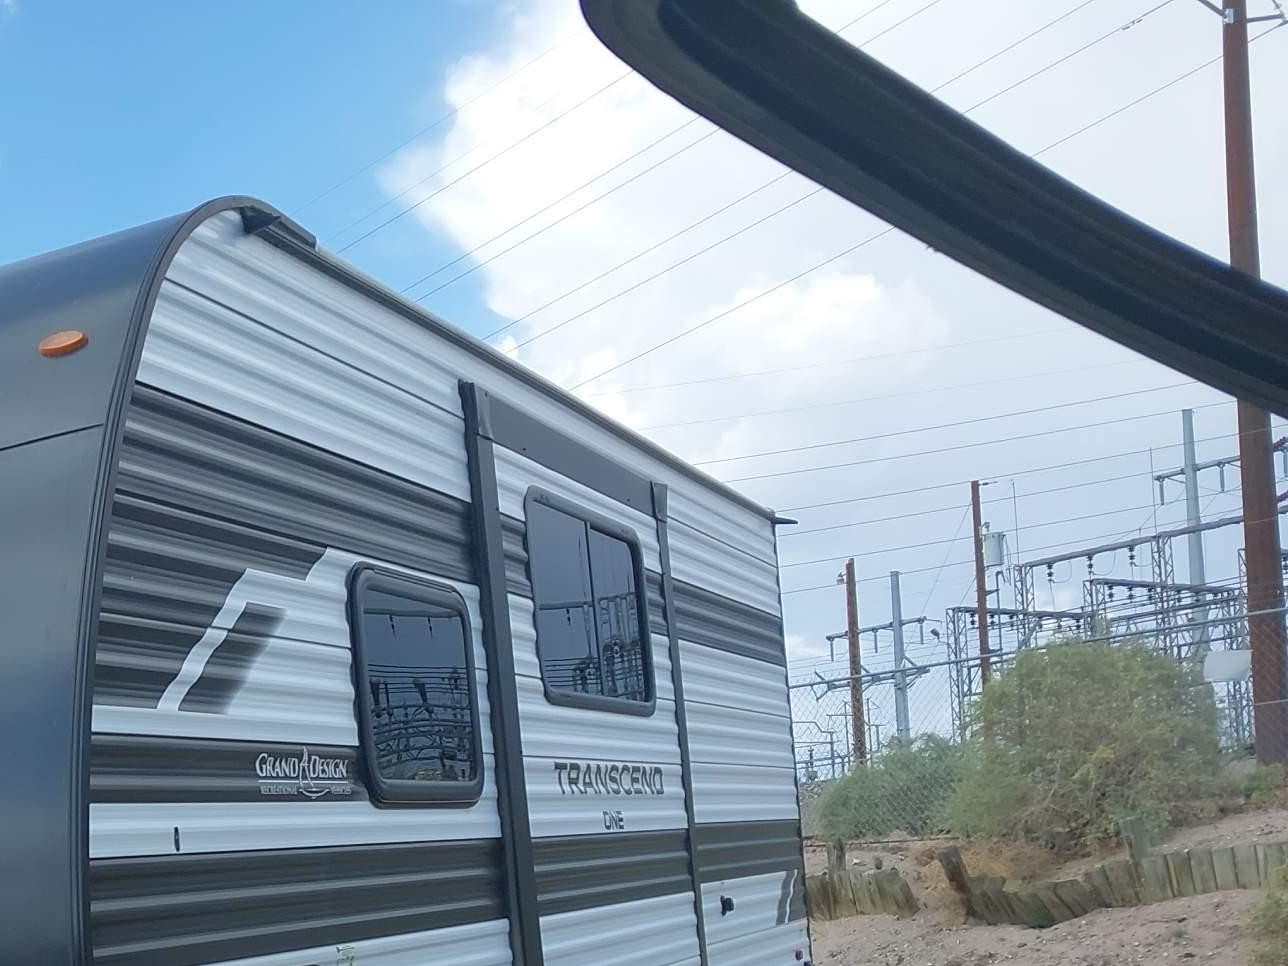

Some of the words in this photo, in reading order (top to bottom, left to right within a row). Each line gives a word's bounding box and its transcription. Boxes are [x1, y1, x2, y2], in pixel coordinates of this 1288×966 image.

[255, 753, 299, 777] GRAND
[310, 755, 349, 778] DESIGN
[554, 762, 665, 795] TRANSCEND
[602, 810, 625, 830] ONE
